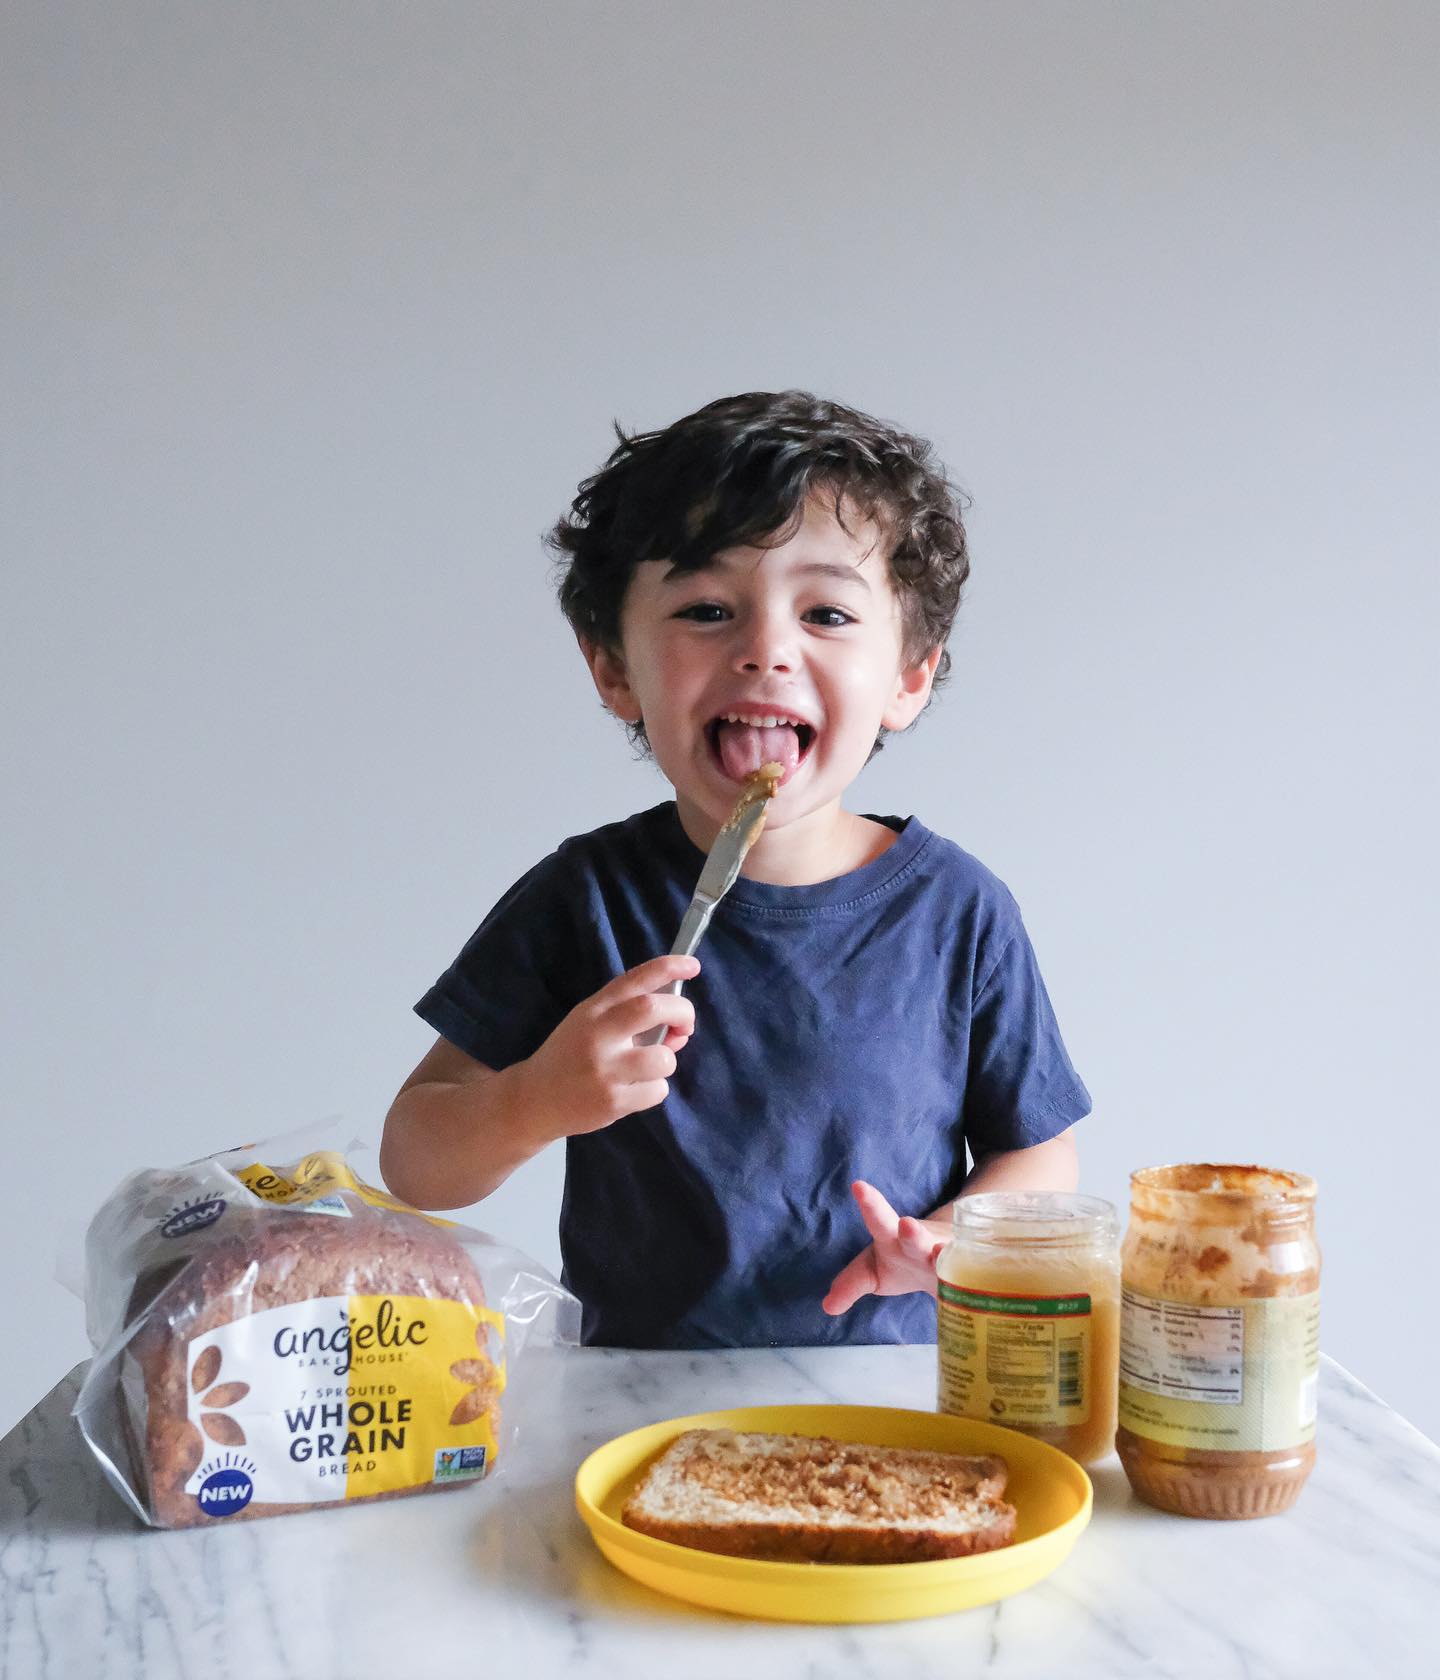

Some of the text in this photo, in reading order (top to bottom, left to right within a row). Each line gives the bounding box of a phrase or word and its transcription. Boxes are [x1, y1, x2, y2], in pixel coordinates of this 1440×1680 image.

[274, 1299, 428, 1376] angelic
[316, 1384, 397, 1399] SPROUTED
[284, 1399, 413, 1433] WHOLE
[289, 1427, 405, 1462] GRAIN
[318, 1460, 377, 1477] BREAD
[201, 1484, 250, 1503] NEW
